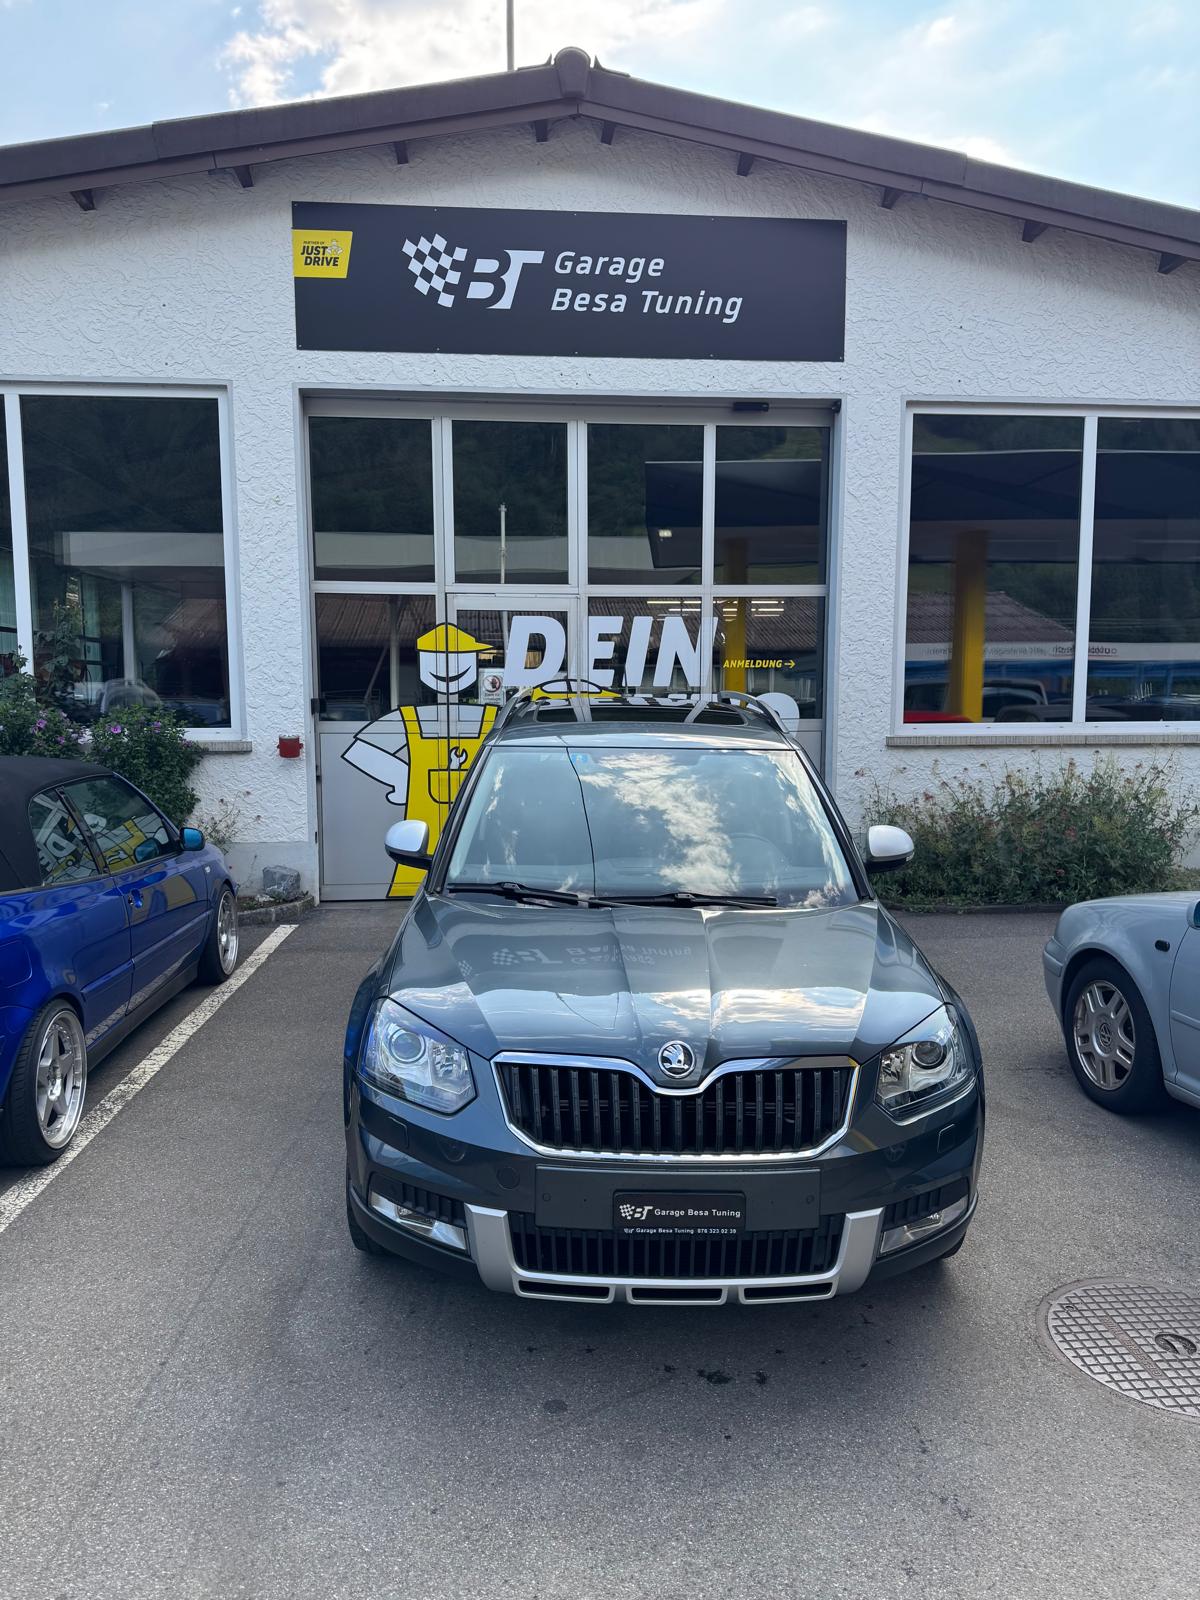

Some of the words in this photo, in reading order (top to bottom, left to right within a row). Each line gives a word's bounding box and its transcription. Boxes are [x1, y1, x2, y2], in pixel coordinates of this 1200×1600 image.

[300, 245, 329, 256] JUST
[304, 256, 340, 267] DRIVE
[554, 250, 665, 284] Garage
[550, 288, 628, 313] Besa
[641, 289, 743, 324] Tuning
[502, 615, 719, 687] DEIN
[723, 659, 783, 669] ANMELDUNG
[654, 1208, 685, 1217] Garage
[711, 1209, 741, 1218] Tuning
[674, 1227, 695, 1235] Tuning
